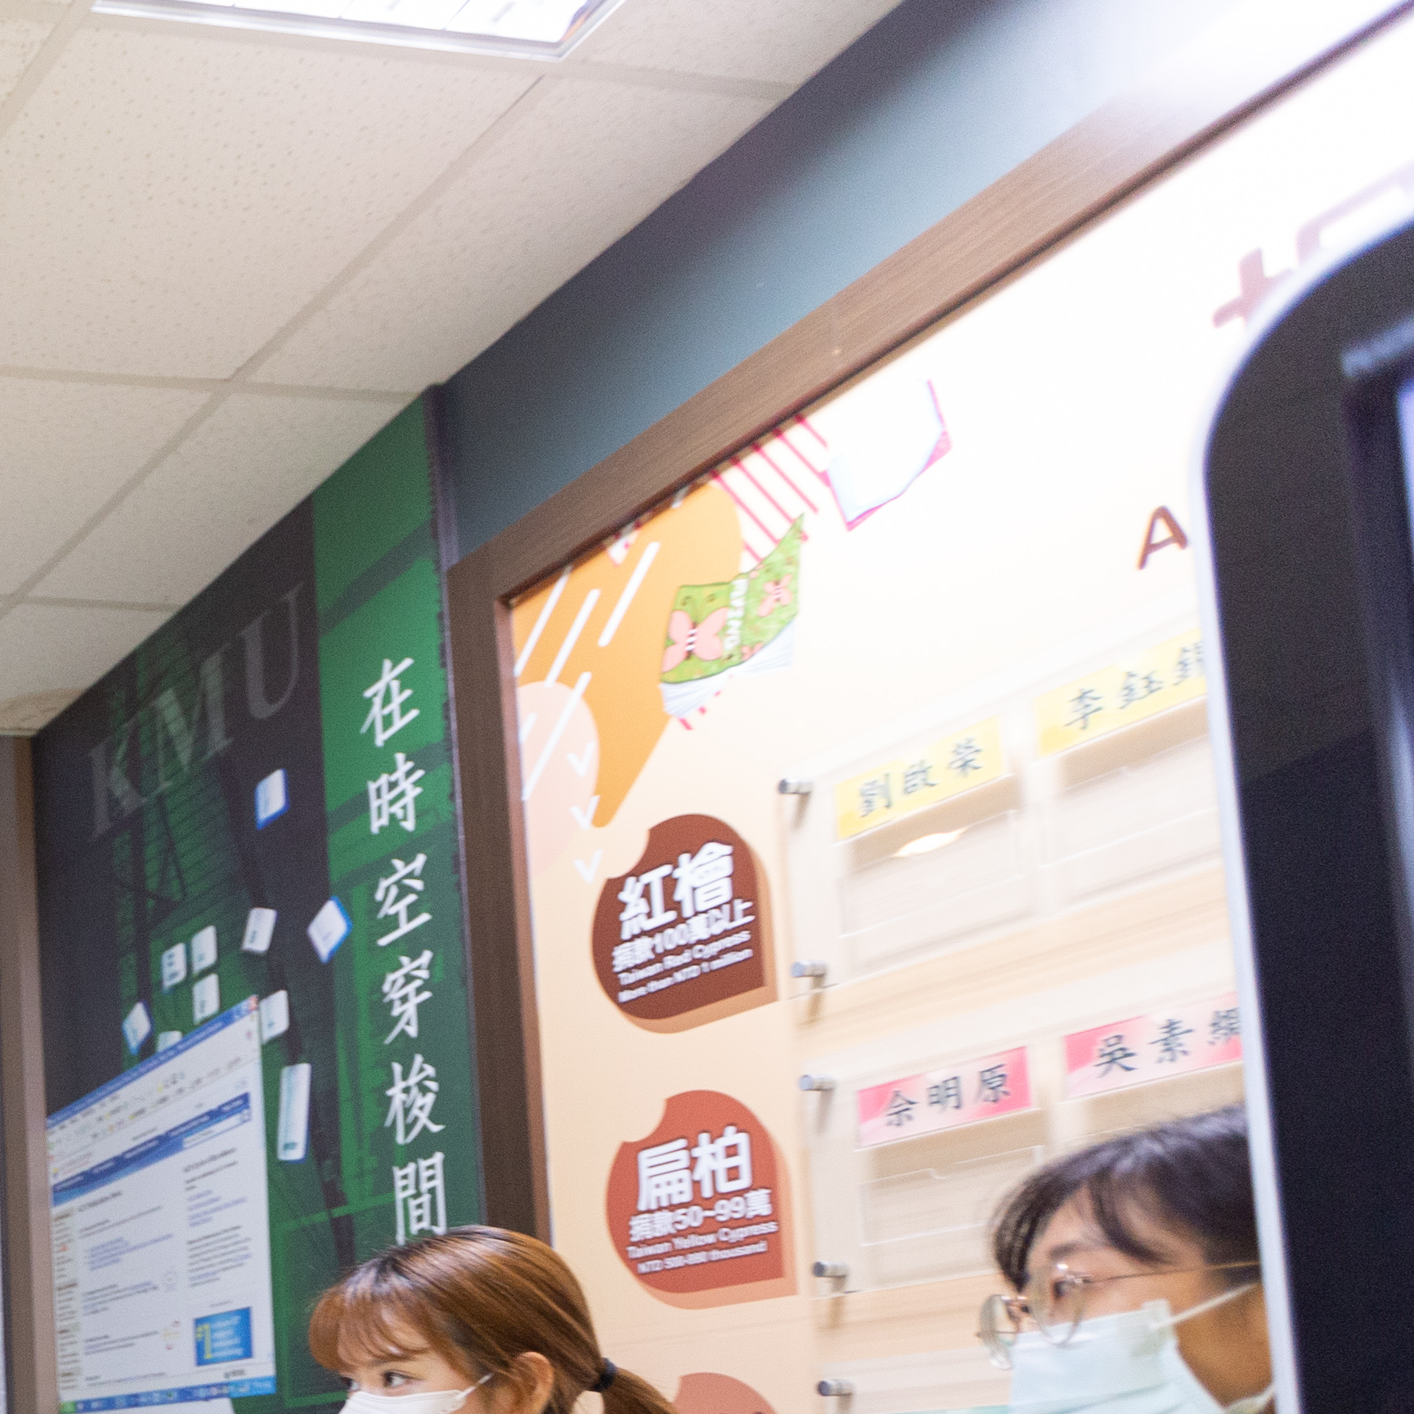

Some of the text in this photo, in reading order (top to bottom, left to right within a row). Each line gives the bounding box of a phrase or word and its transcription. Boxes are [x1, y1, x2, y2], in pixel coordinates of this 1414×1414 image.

[86, 582, 303, 842] KMU
[360, 656, 449, 1248] 在時空穿梭間
[617, 841, 734, 940] 紅檜
[637, 1125, 753, 1211] 扁柏
